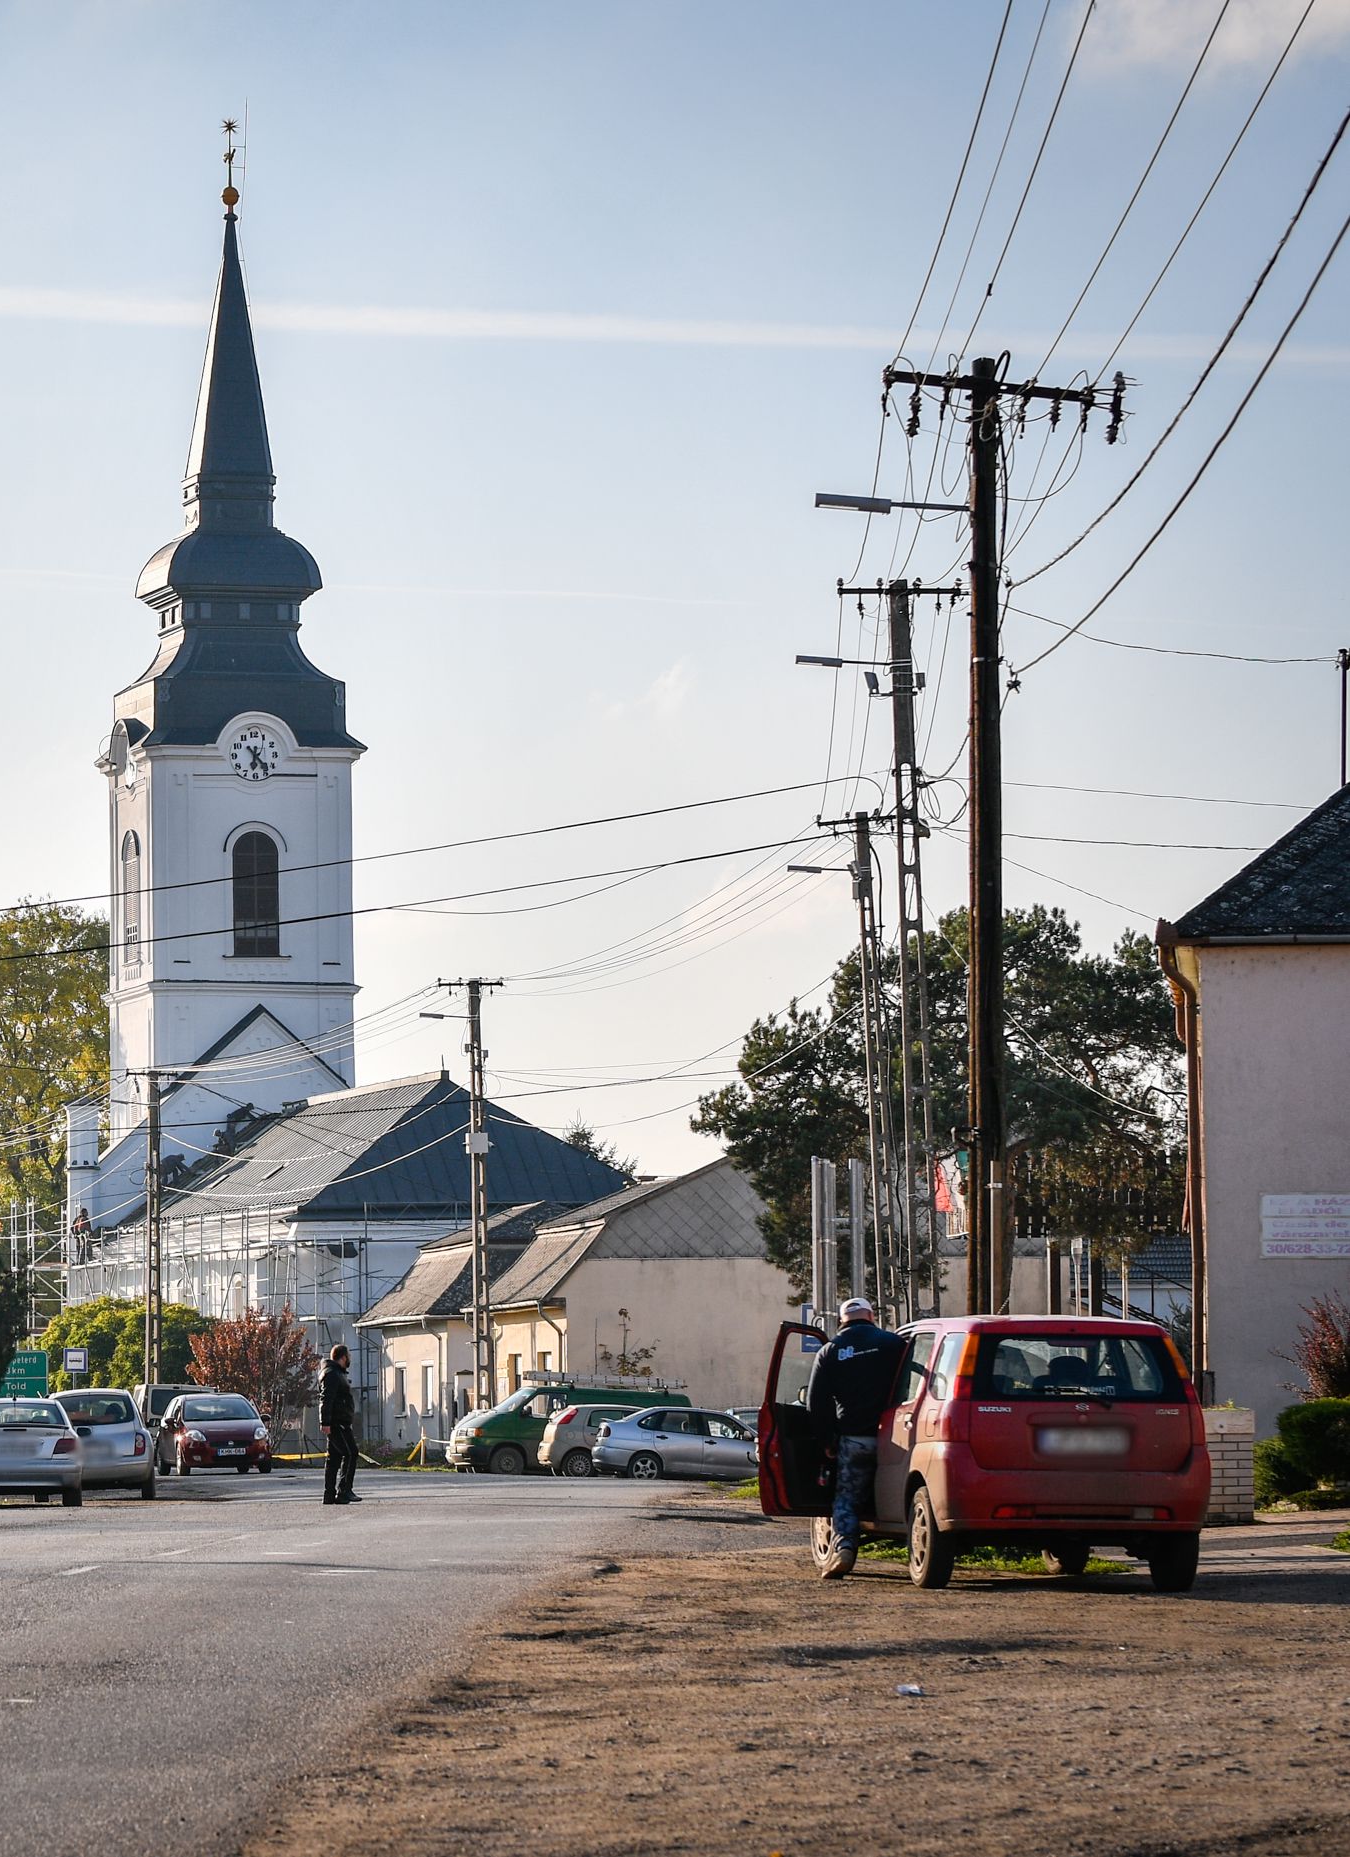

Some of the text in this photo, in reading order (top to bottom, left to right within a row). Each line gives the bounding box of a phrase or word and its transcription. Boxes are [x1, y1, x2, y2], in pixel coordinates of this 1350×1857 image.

[231, 752, 237, 760] 9
[272, 751, 278, 759] 3
[12, 1356, 37, 1364] peterd
[5, 1382, 26, 1390] Told
